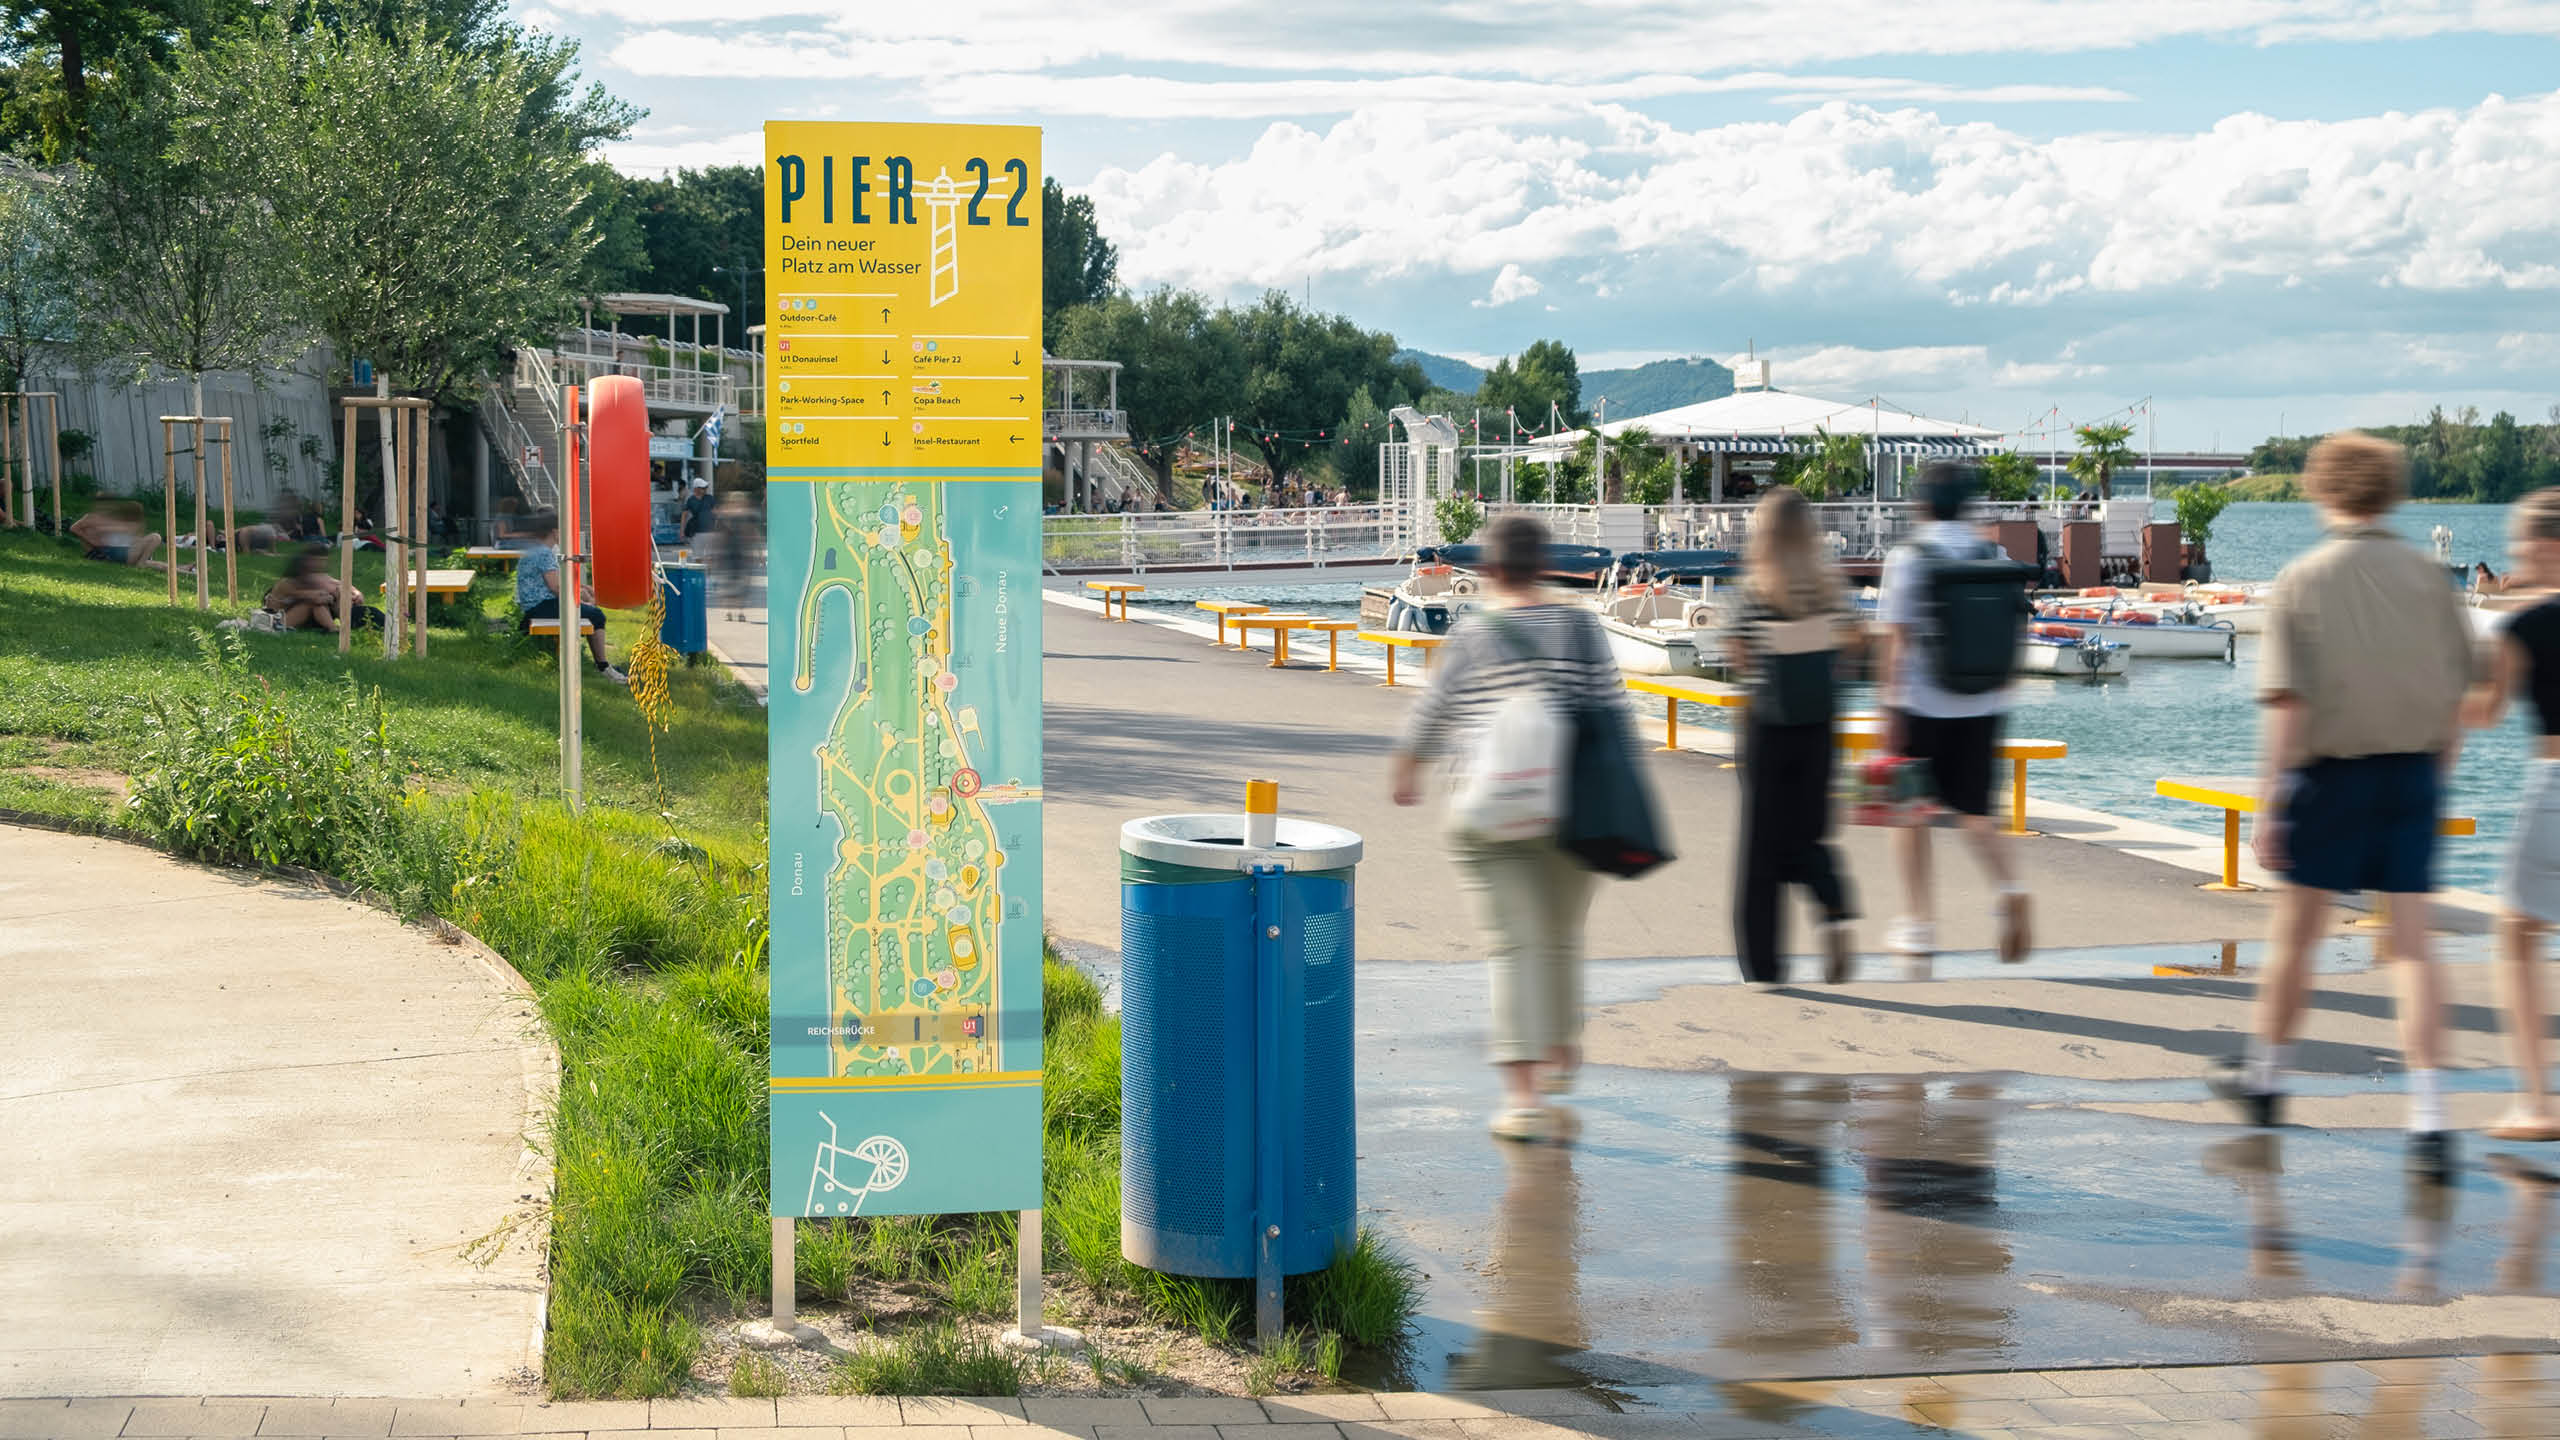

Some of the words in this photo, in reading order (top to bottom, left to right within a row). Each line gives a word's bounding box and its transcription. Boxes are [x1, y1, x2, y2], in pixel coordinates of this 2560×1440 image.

[776, 155, 917, 224] PIER
[965, 157, 1029, 227] 22
[782, 235, 821, 251] Dein
[826, 239, 876, 251] neuer
[782, 258, 824, 274] Platz
[828, 262, 854, 274] am
[859, 258, 922, 275] Wasser
[780, 313, 837, 322] Outdoor-Café
[780, 355, 791, 363] U1
[792, 355, 838, 363] Donauinsel
[913, 355, 932, 363] Café
[934, 355, 950, 363] Pier
[780, 396, 865, 405] Park-Working-Space
[913, 396, 935, 405] Copa
[936, 396, 961, 404] Beach
[780, 437, 819, 446] Sportfeld
[913, 437, 980, 445] Insel-Restaurant
[995, 570, 1008, 614] Donau
[995, 619, 1008, 653] Neue
[791, 853, 804, 896] Donau
[963, 1020, 976, 1030] U1
[807, 1025, 875, 1036] REICHSBRÜCKE
